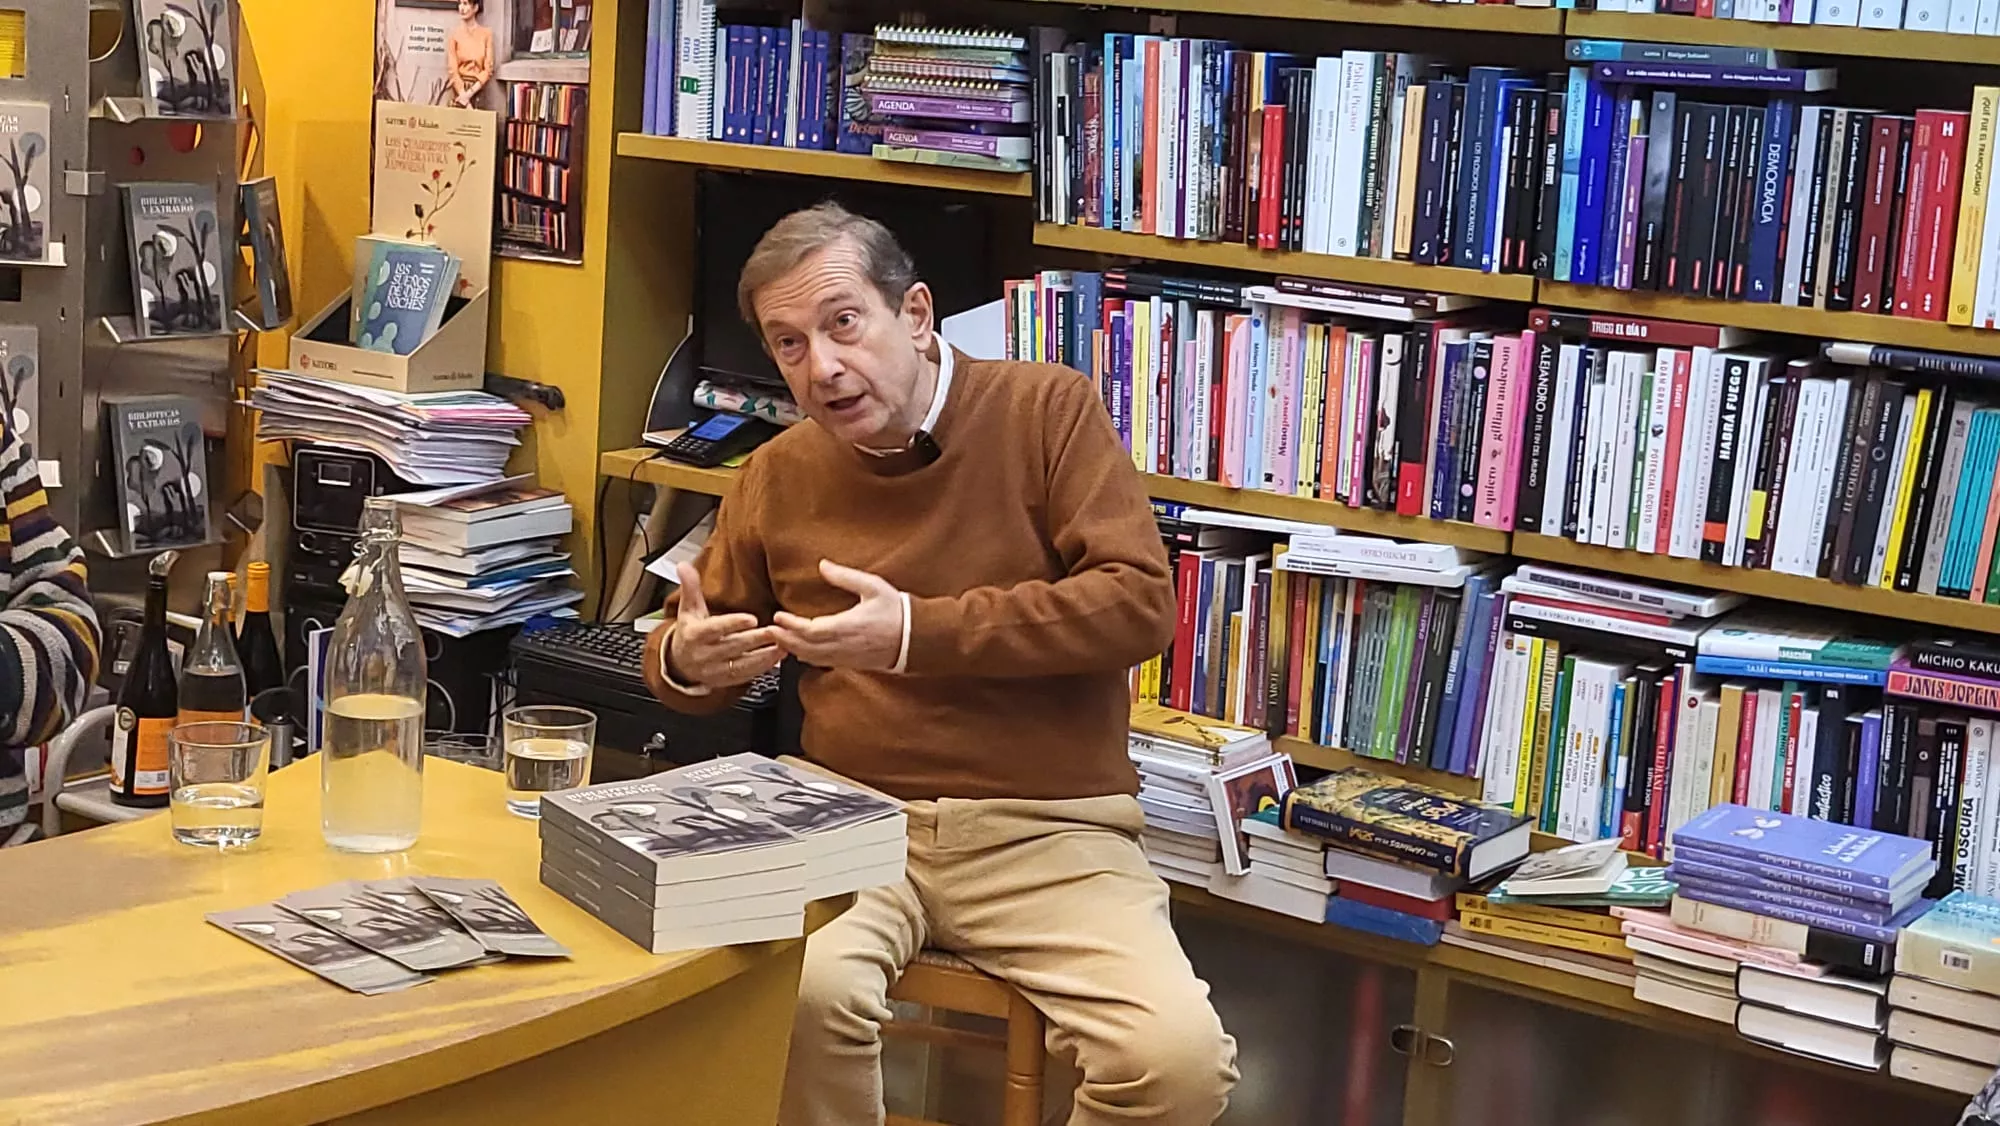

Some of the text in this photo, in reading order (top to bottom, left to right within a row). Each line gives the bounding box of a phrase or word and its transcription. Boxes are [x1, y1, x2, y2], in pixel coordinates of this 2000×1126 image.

[878, 101, 915, 111] AGENDA
[1349, 62, 1364, 131] Pablo Picasso
[386, 136, 401, 147] LOS
[888, 133, 918, 143] AGENDA
[1850, 136, 1859, 154] Carlos
[398, 150, 448, 164] LITERATURA
[1470, 155, 1481, 190] FILÓSOFOS
[1760, 143, 1780, 223] DEMOCRACIA
[140, 197, 193, 206] BIBLIOTECAS
[395, 263, 412, 275] LOS
[385, 296, 424, 311] NOCHES
[388, 285, 428, 300] DE DIEZ
[1591, 322, 1613, 335] TRIGO
[1534, 345, 1552, 411] ALEJANDRO
[1658, 360, 1668, 384] ADAM
[1111, 380, 1121, 415] FEMINISMO
[1654, 386, 1665, 414] GRANT
[128, 409, 180, 420] BIBLIOTECAS
[129, 421, 135, 430] Y
[1278, 396, 1291, 456] Menopower
[1484, 346, 1510, 504] quiero gillian anderson
[1718, 365, 1741, 459] HABRÁ FUEGO
[1528, 458, 1538, 486] MUNDO
[1645, 448, 1657, 489] POTENCIAL
[1844, 452, 1863, 498] COLISEO
[1641, 492, 1652, 522] OCULTO
[1813, 505, 1823, 533] VIRGEN
[1360, 548, 1382, 557] CIEGO
[1383, 550, 1406, 560] PUNTO
[1548, 611, 1575, 622] VIRGEN
[1577, 615, 1595, 625] ROJA
[1542, 647, 1559, 676] ALBERT
[1917, 653, 1999, 674] MICHIO KAKU
[1267, 671, 1279, 705] TAROT
[1537, 677, 1554, 711] ESPINOSA
[1904, 674, 1999, 708] JANIS JOPLIN
[1568, 724, 1576, 756] MANDARLO
[1585, 728, 1594, 761] MANDARLO
[1777, 735, 1787, 757] JOHN
[1651, 743, 1667, 790] INVICTO
[1973, 749, 1986, 788] SOMMER
[565, 783, 657, 801] BIBLIOTECAS
[1955, 797, 1974, 858] OSCURA
[1388, 839, 1426, 855] CAMINOS
